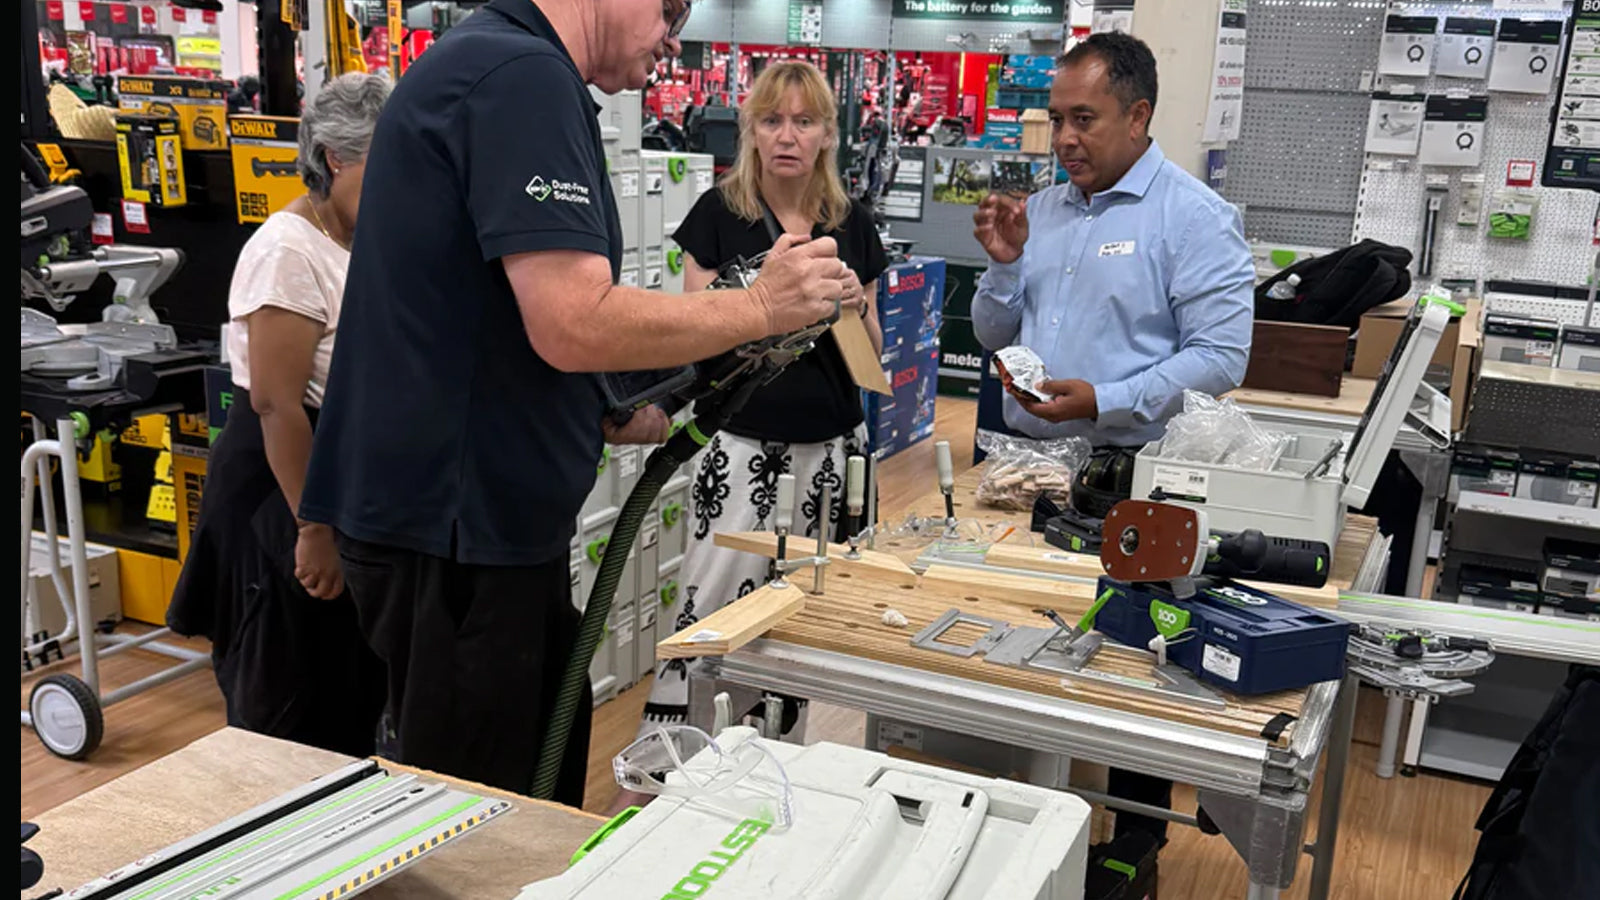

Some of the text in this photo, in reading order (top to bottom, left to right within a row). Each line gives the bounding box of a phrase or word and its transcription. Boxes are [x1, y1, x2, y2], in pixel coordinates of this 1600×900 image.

[905, 1, 1052, 16] The battery for the garden
[119, 80, 154, 93] DEWALT
[231, 120, 277, 138] DEWALT
[553, 191, 591, 204] Solutions
[660, 818, 774, 900] ESTOO
